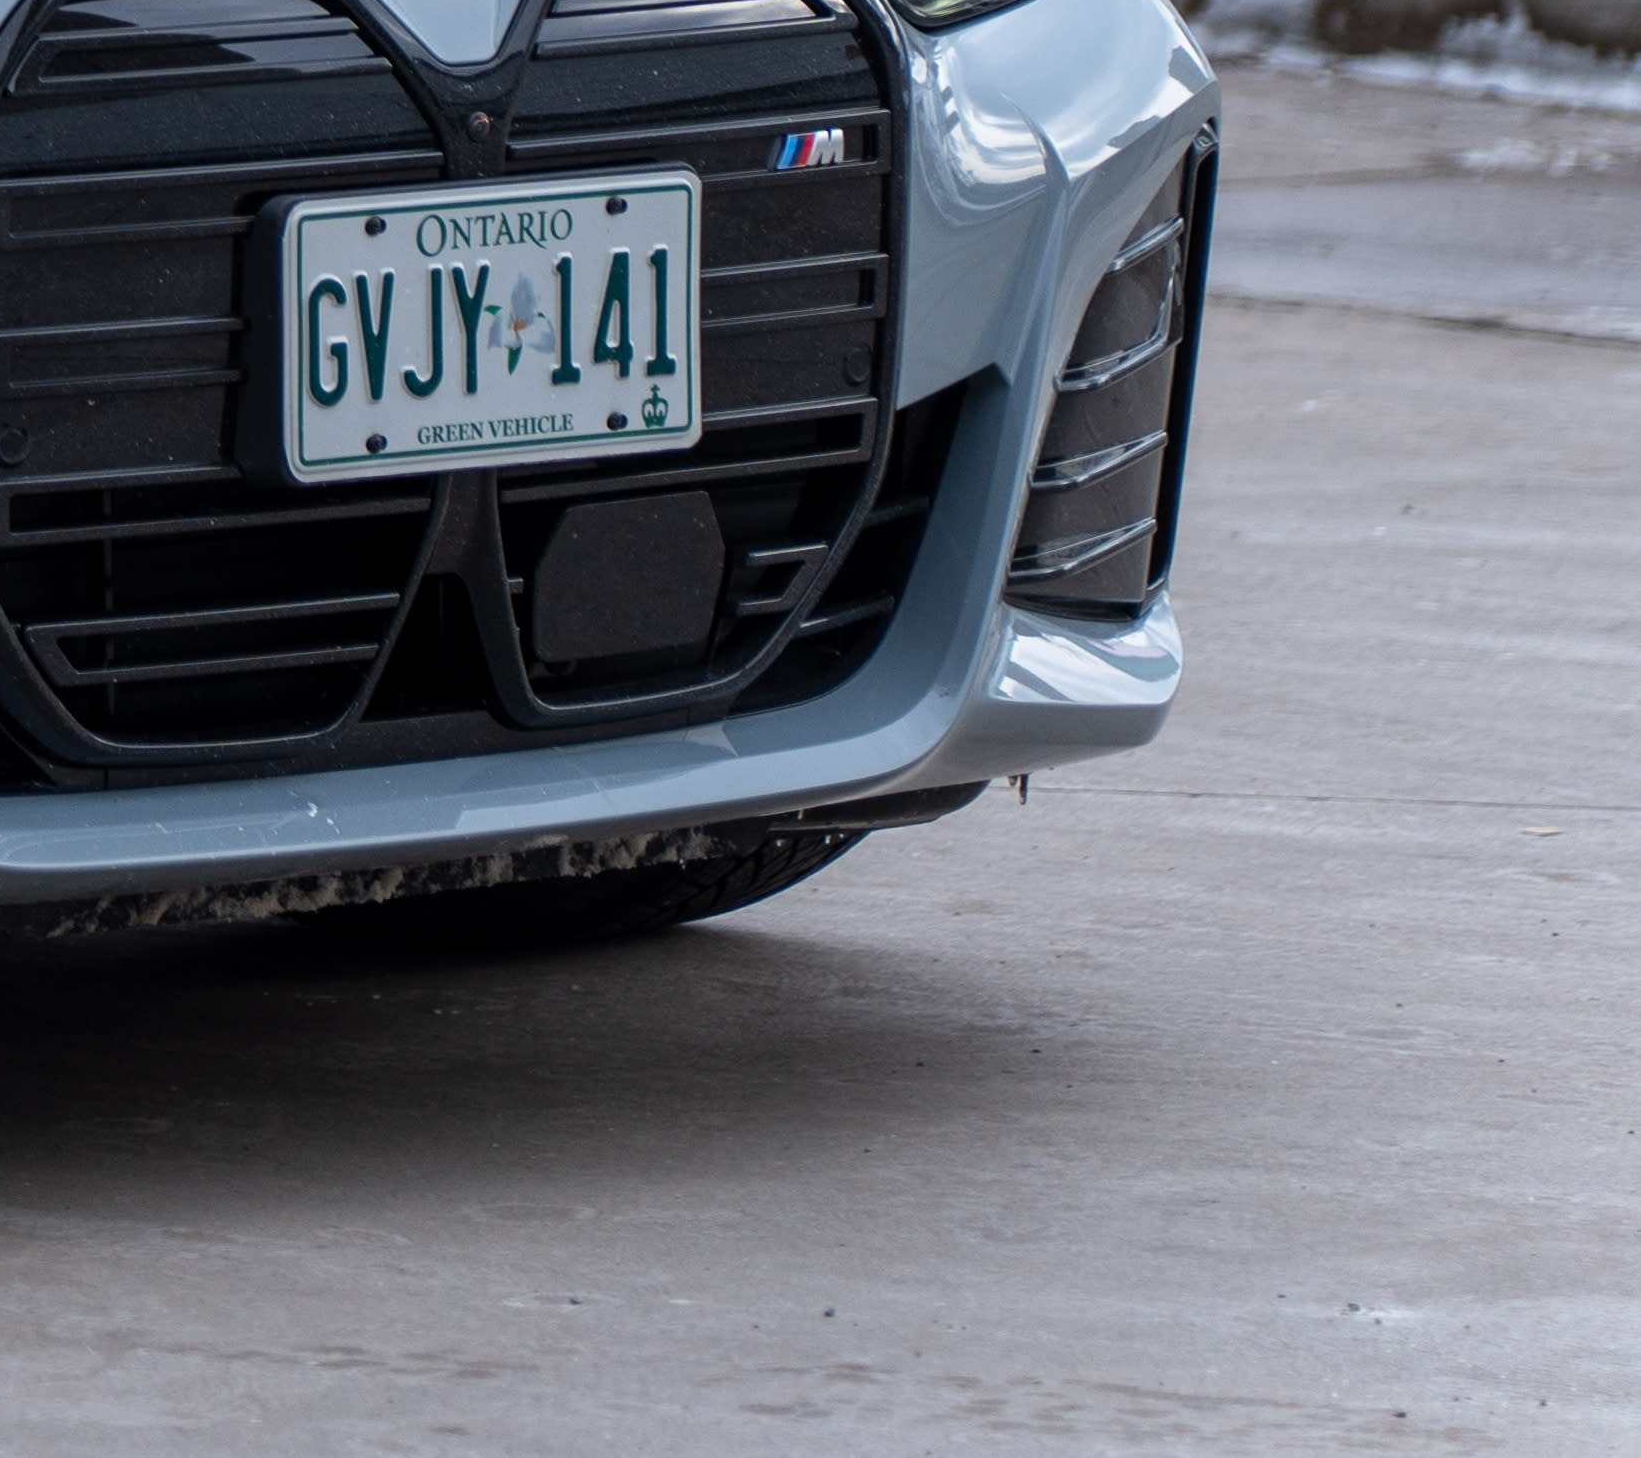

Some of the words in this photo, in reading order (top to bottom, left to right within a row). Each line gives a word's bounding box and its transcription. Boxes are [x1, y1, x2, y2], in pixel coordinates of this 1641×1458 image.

[416, 208, 574, 257] ONTARIO
[308, 259, 491, 407] GVJY
[550, 243, 678, 386] 141
[417, 420, 484, 446] GREEN
[488, 413, 575, 440] VEHICLE
